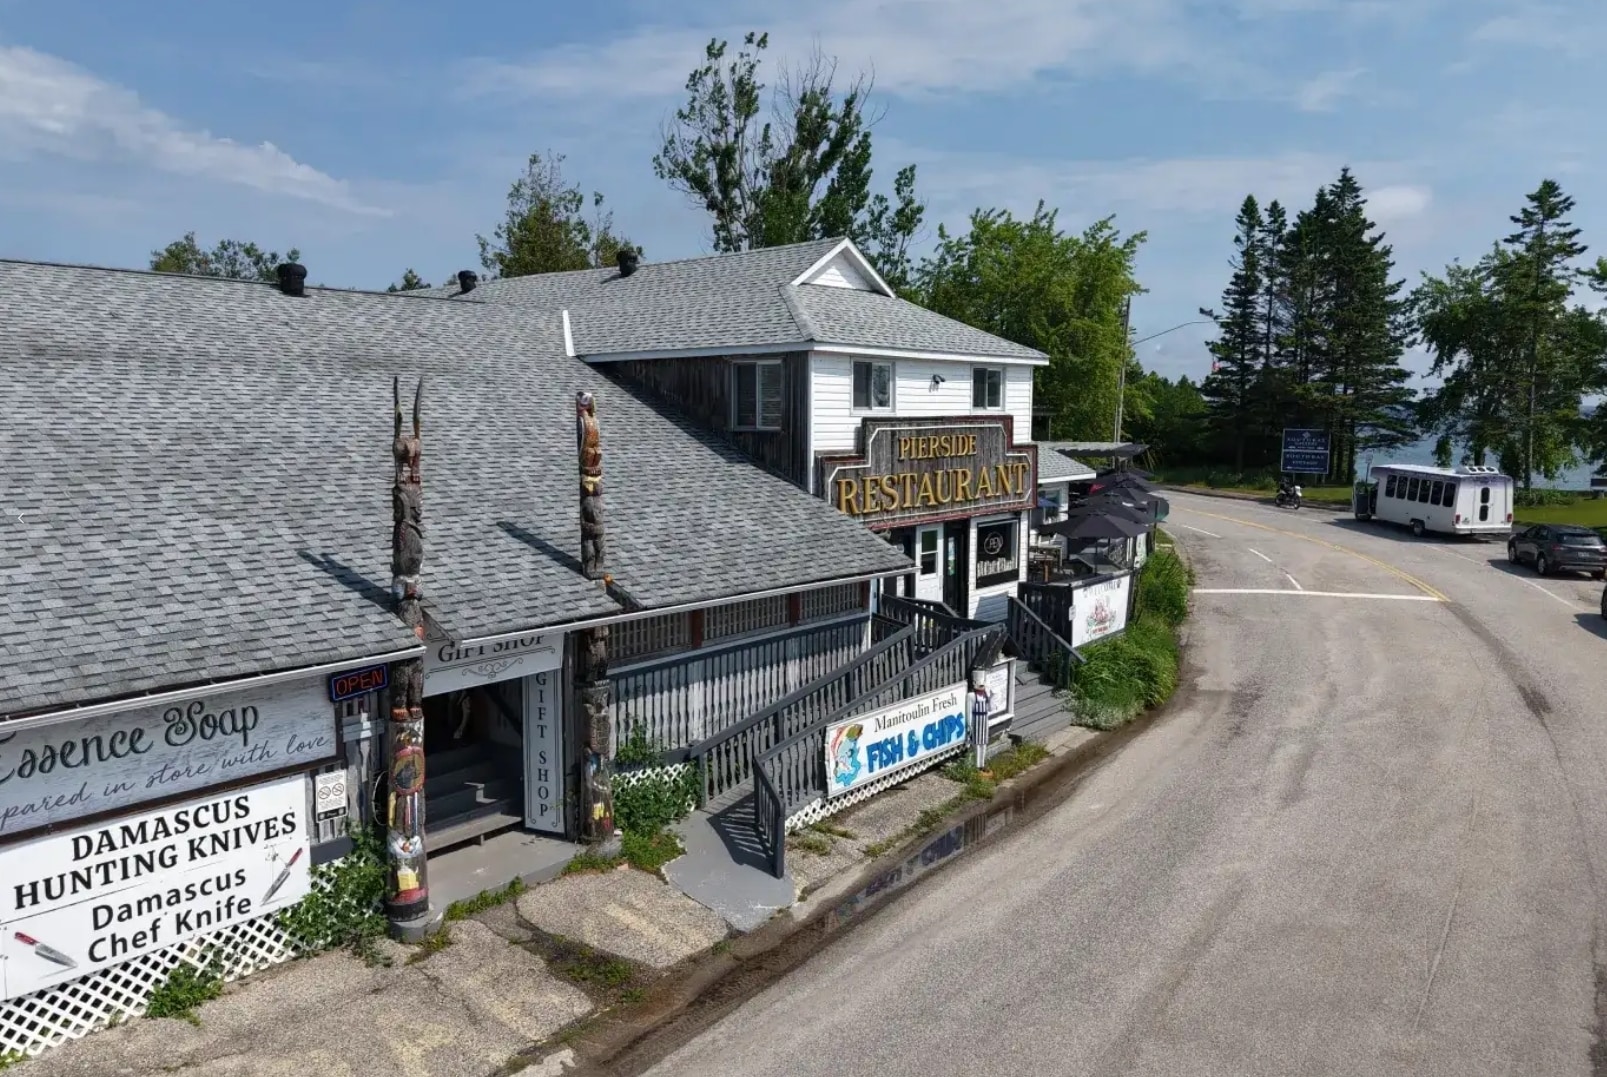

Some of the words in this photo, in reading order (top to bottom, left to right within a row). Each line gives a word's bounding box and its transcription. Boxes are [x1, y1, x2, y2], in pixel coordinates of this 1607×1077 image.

[898, 434, 977, 461] PIERSIDE
[836, 462, 1029, 515] RESTAURANT
[335, 669, 384, 695] OPEN
[536, 671, 548, 738] GIFT
[874, 703, 930, 733] Manitoulin
[931, 692, 958, 713] Fresh
[0, 727, 153, 784] ssence
[163, 700, 259, 747] Soap
[103, 782, 136, 797] in
[145, 762, 210, 788] store
[221, 740, 278, 769] with
[286, 734, 330, 754] love
[866, 732, 904, 774] FISH
[907, 729, 920, 757] &
[922, 711, 965, 751] CHIPS
[537, 750, 549, 817] SHOP
[71, 795, 251, 862] DAMASCUS
[13, 844, 179, 910] HUNTING
[187, 811, 297, 862] KNIVES
[87, 918, 161, 963] Chef
[175, 895, 252, 935] Knife
[91, 868, 247, 931] Damascus
